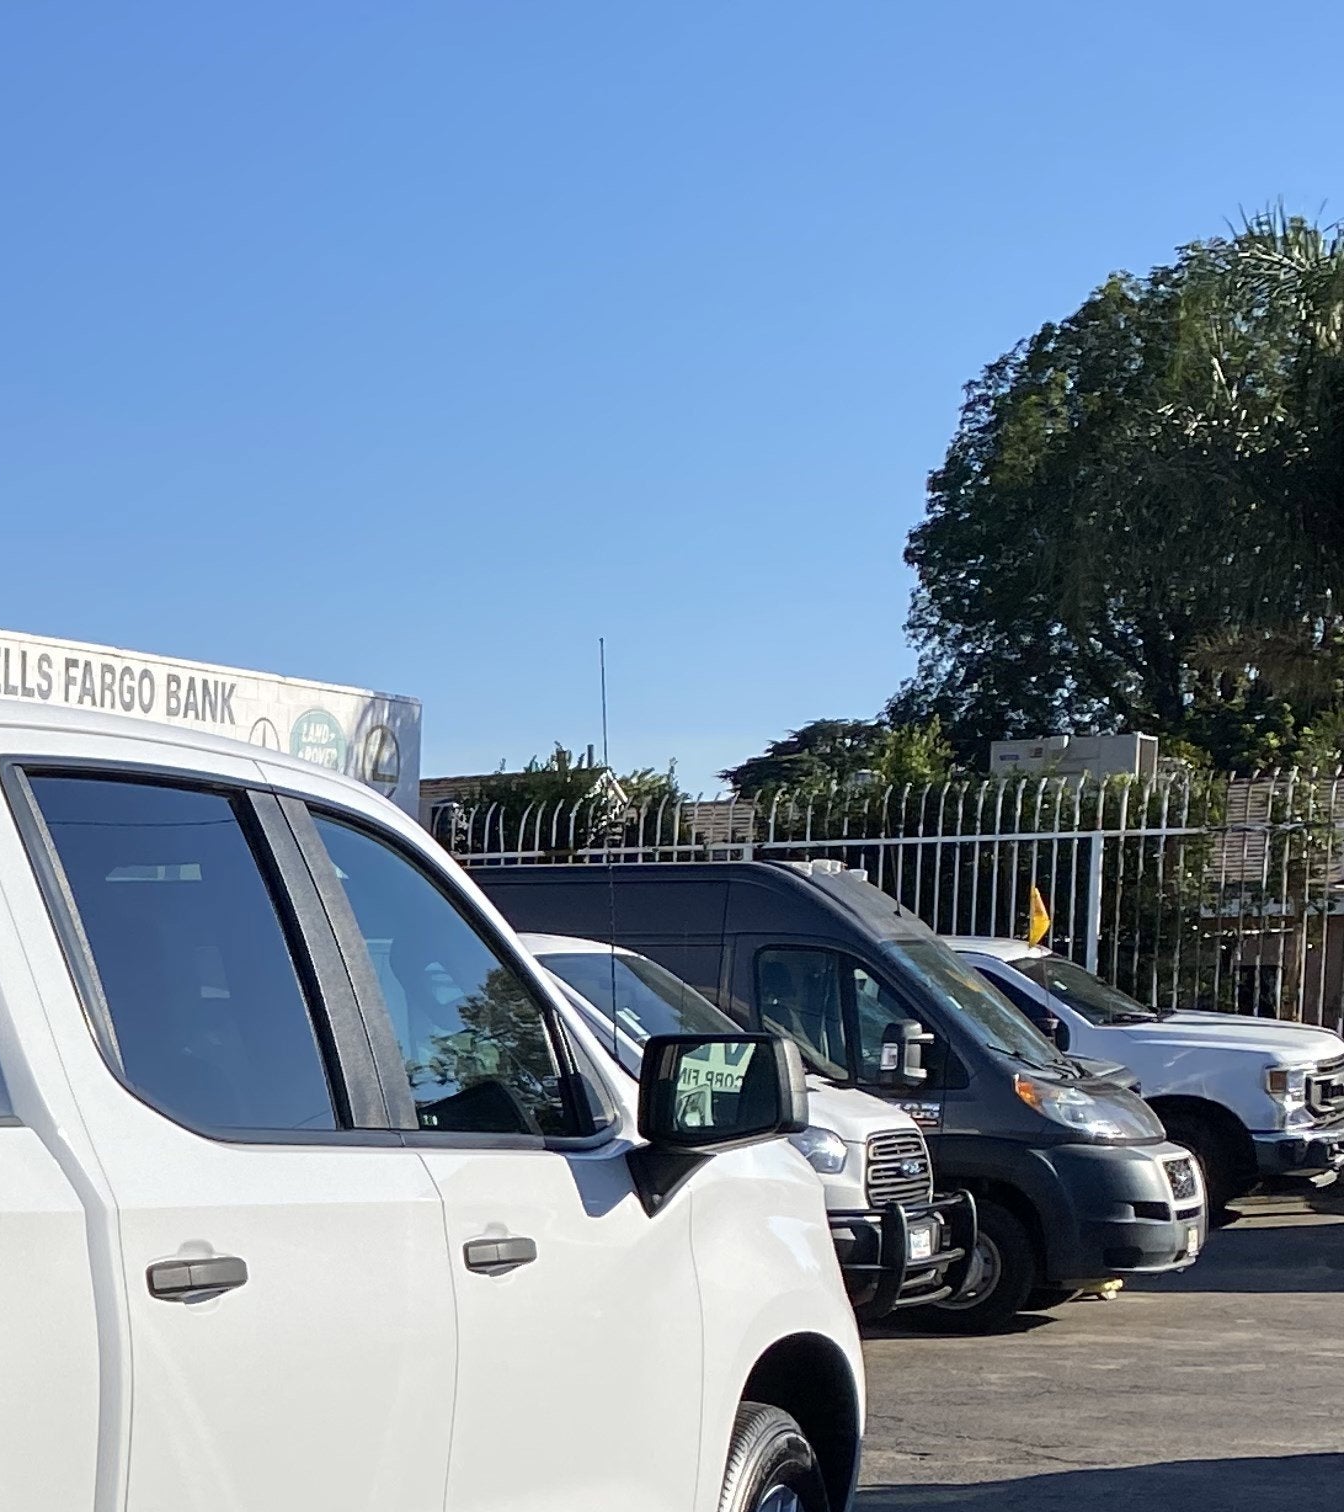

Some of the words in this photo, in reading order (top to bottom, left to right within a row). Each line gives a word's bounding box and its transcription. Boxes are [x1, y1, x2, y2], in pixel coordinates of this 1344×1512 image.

[64, 657, 155, 714] FARGO
[165, 673, 236, 725] BANK
[302, 721, 333, 744] LAND
[303, 747, 338, 770] ROVER
